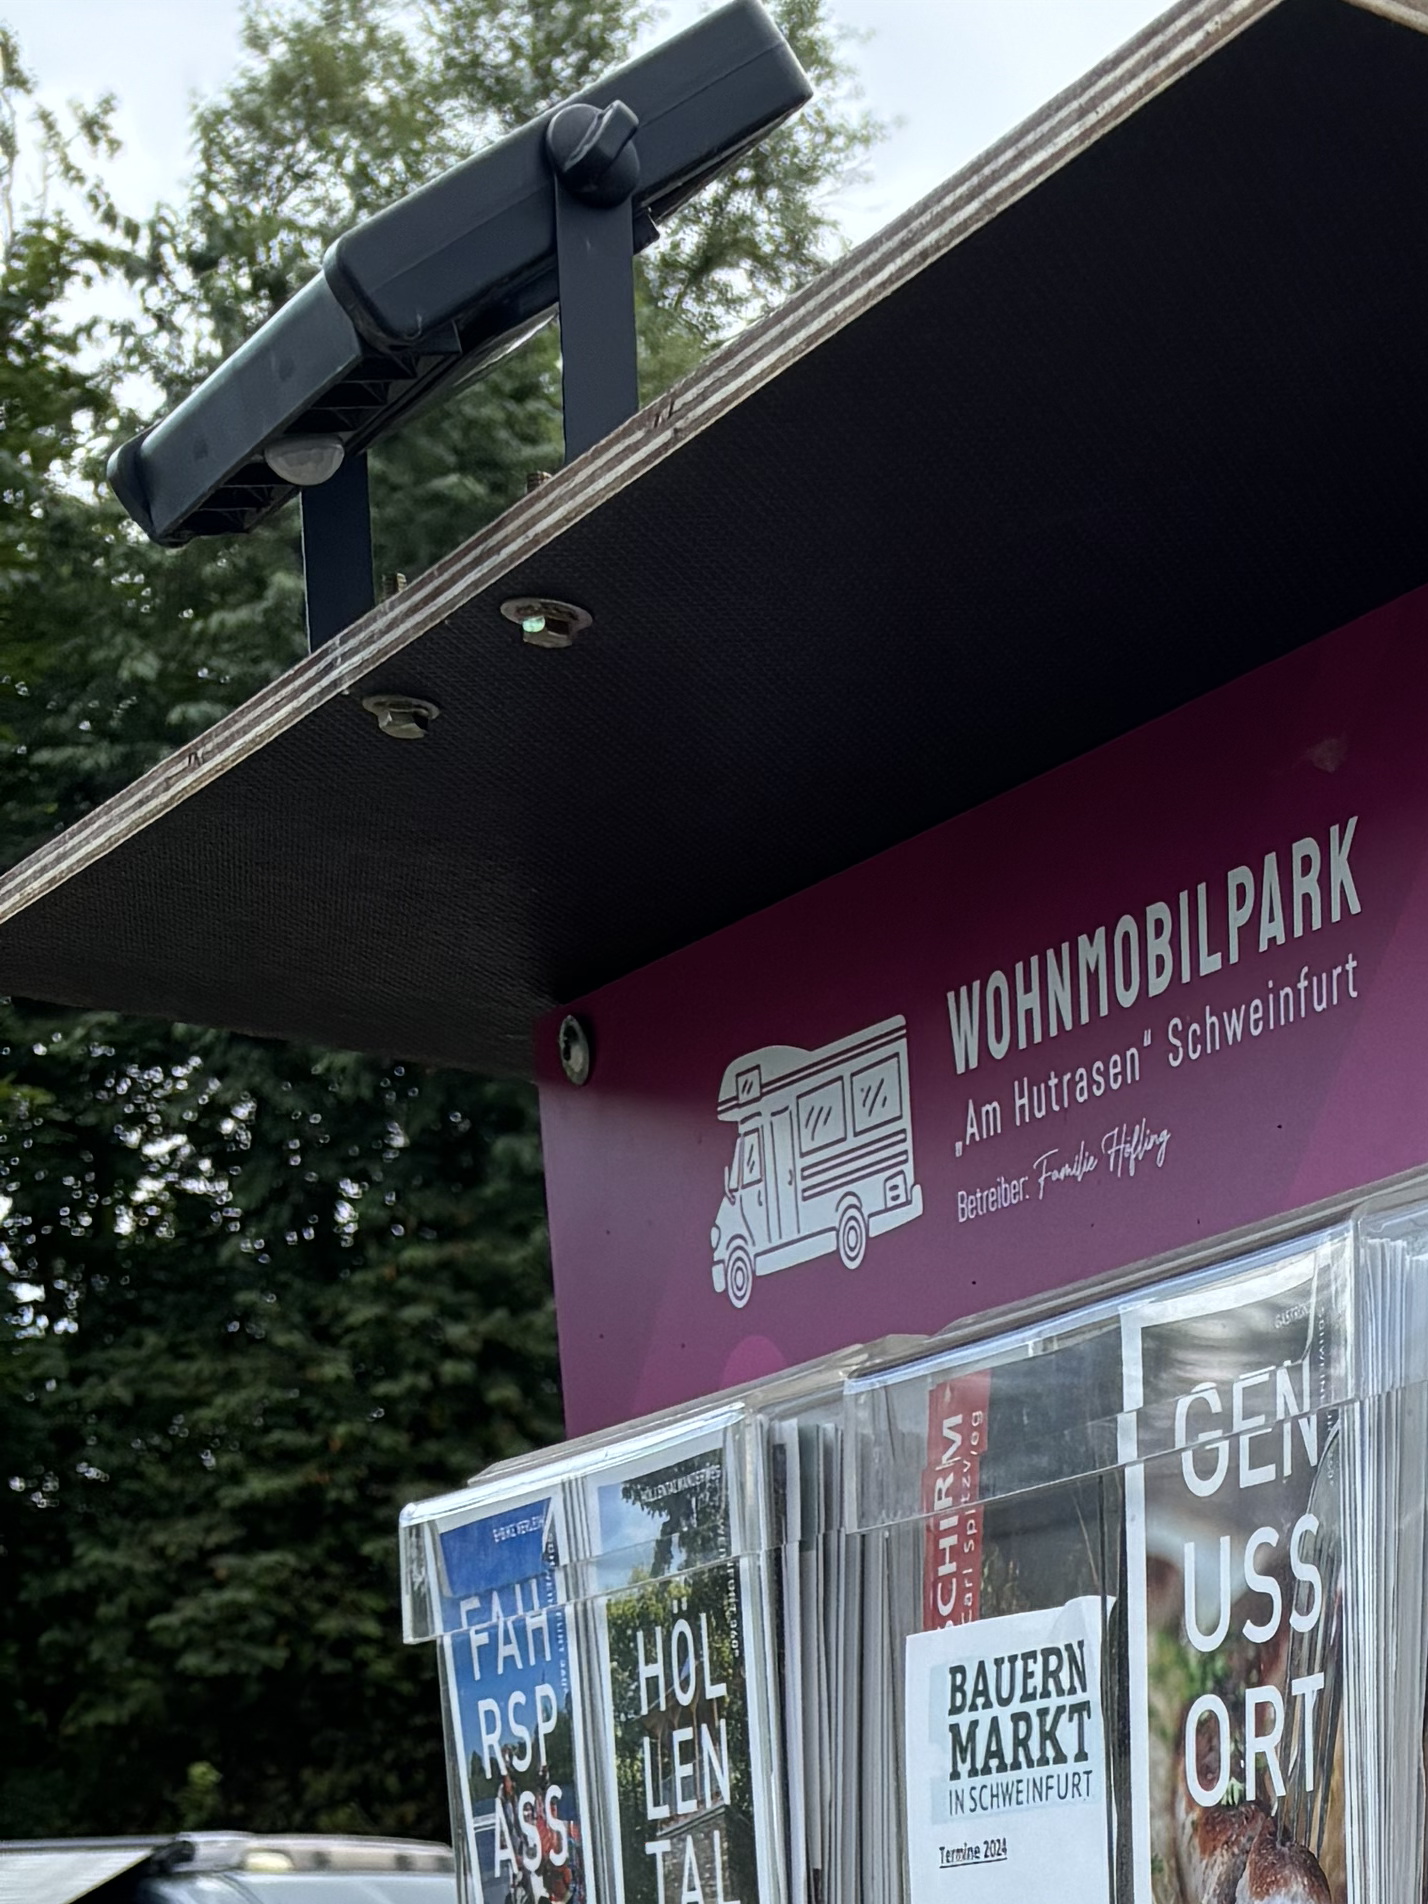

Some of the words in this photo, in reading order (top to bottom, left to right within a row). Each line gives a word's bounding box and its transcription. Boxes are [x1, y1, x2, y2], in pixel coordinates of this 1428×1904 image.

[946, 816, 1362, 1075] WOHNMOBILPARK
[1167, 951, 1360, 1067] Schweinfurt
[1175, 1360, 1319, 1497] GEN
[1184, 1513, 1322, 1653] USS
[468, 1610, 552, 1681] FAH
[637, 1597, 727, 1715] HÖL
[948, 1640, 1087, 1717] BAUERN
[478, 1684, 558, 1779] RSP
[644, 1718, 731, 1820] LEN
[948, 1700, 1092, 1782] MARKT
[1185, 1672, 1325, 1807] ORT
[493, 1785, 569, 1878] ASS
[948, 1789, 965, 1815] IN
[968, 1770, 1093, 1813] SCHWEINFURT
[939, 1840, 980, 1866] Termine
[983, 1838, 1007, 1860] 2024
